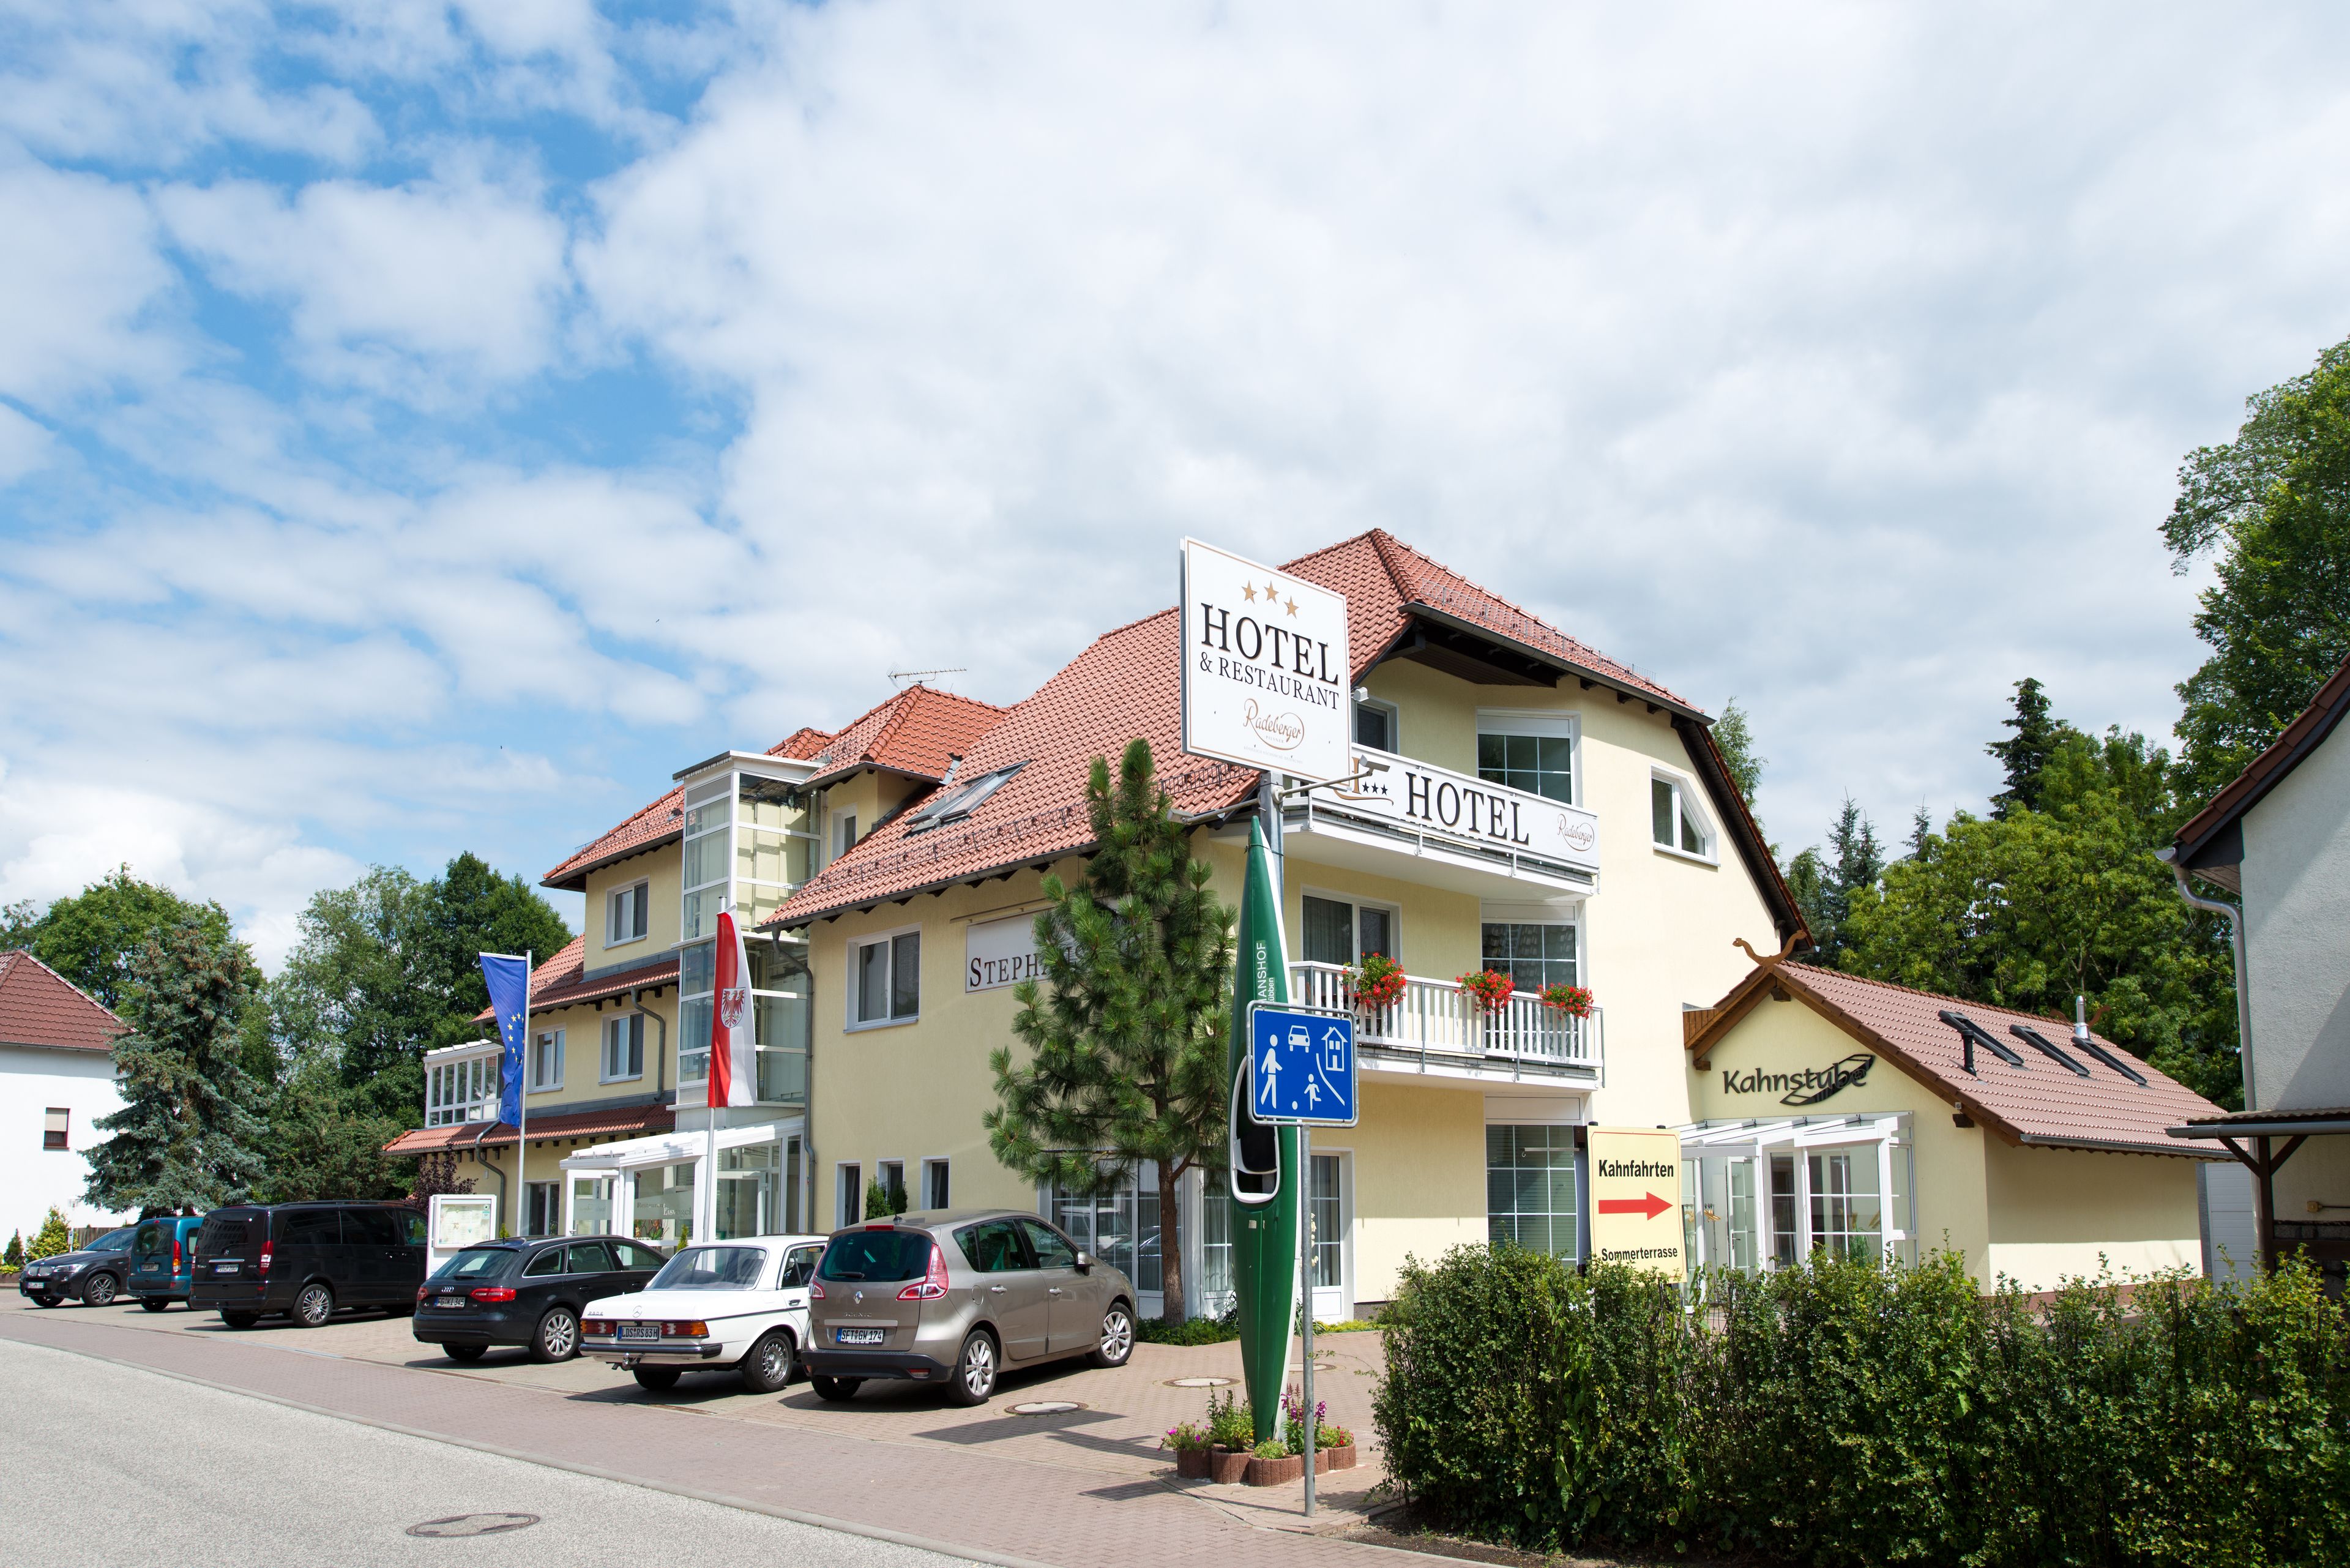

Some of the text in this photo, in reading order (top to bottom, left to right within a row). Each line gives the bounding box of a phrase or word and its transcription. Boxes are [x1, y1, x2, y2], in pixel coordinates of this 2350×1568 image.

[1201, 602, 1338, 686] HOTEL
[1200, 651, 1339, 710] & RESTAURANT
[1243, 698, 1304, 750] Radeberger
[1405, 771, 1529, 846] HOTEL
[1557, 813, 1595, 851] Radeberger
[1722, 1062, 1867, 1094] Kahnstube
[1598, 1159, 1674, 1178] Kahnfahrten
[1602, 1247, 1678, 1261] Sommerterrasse
